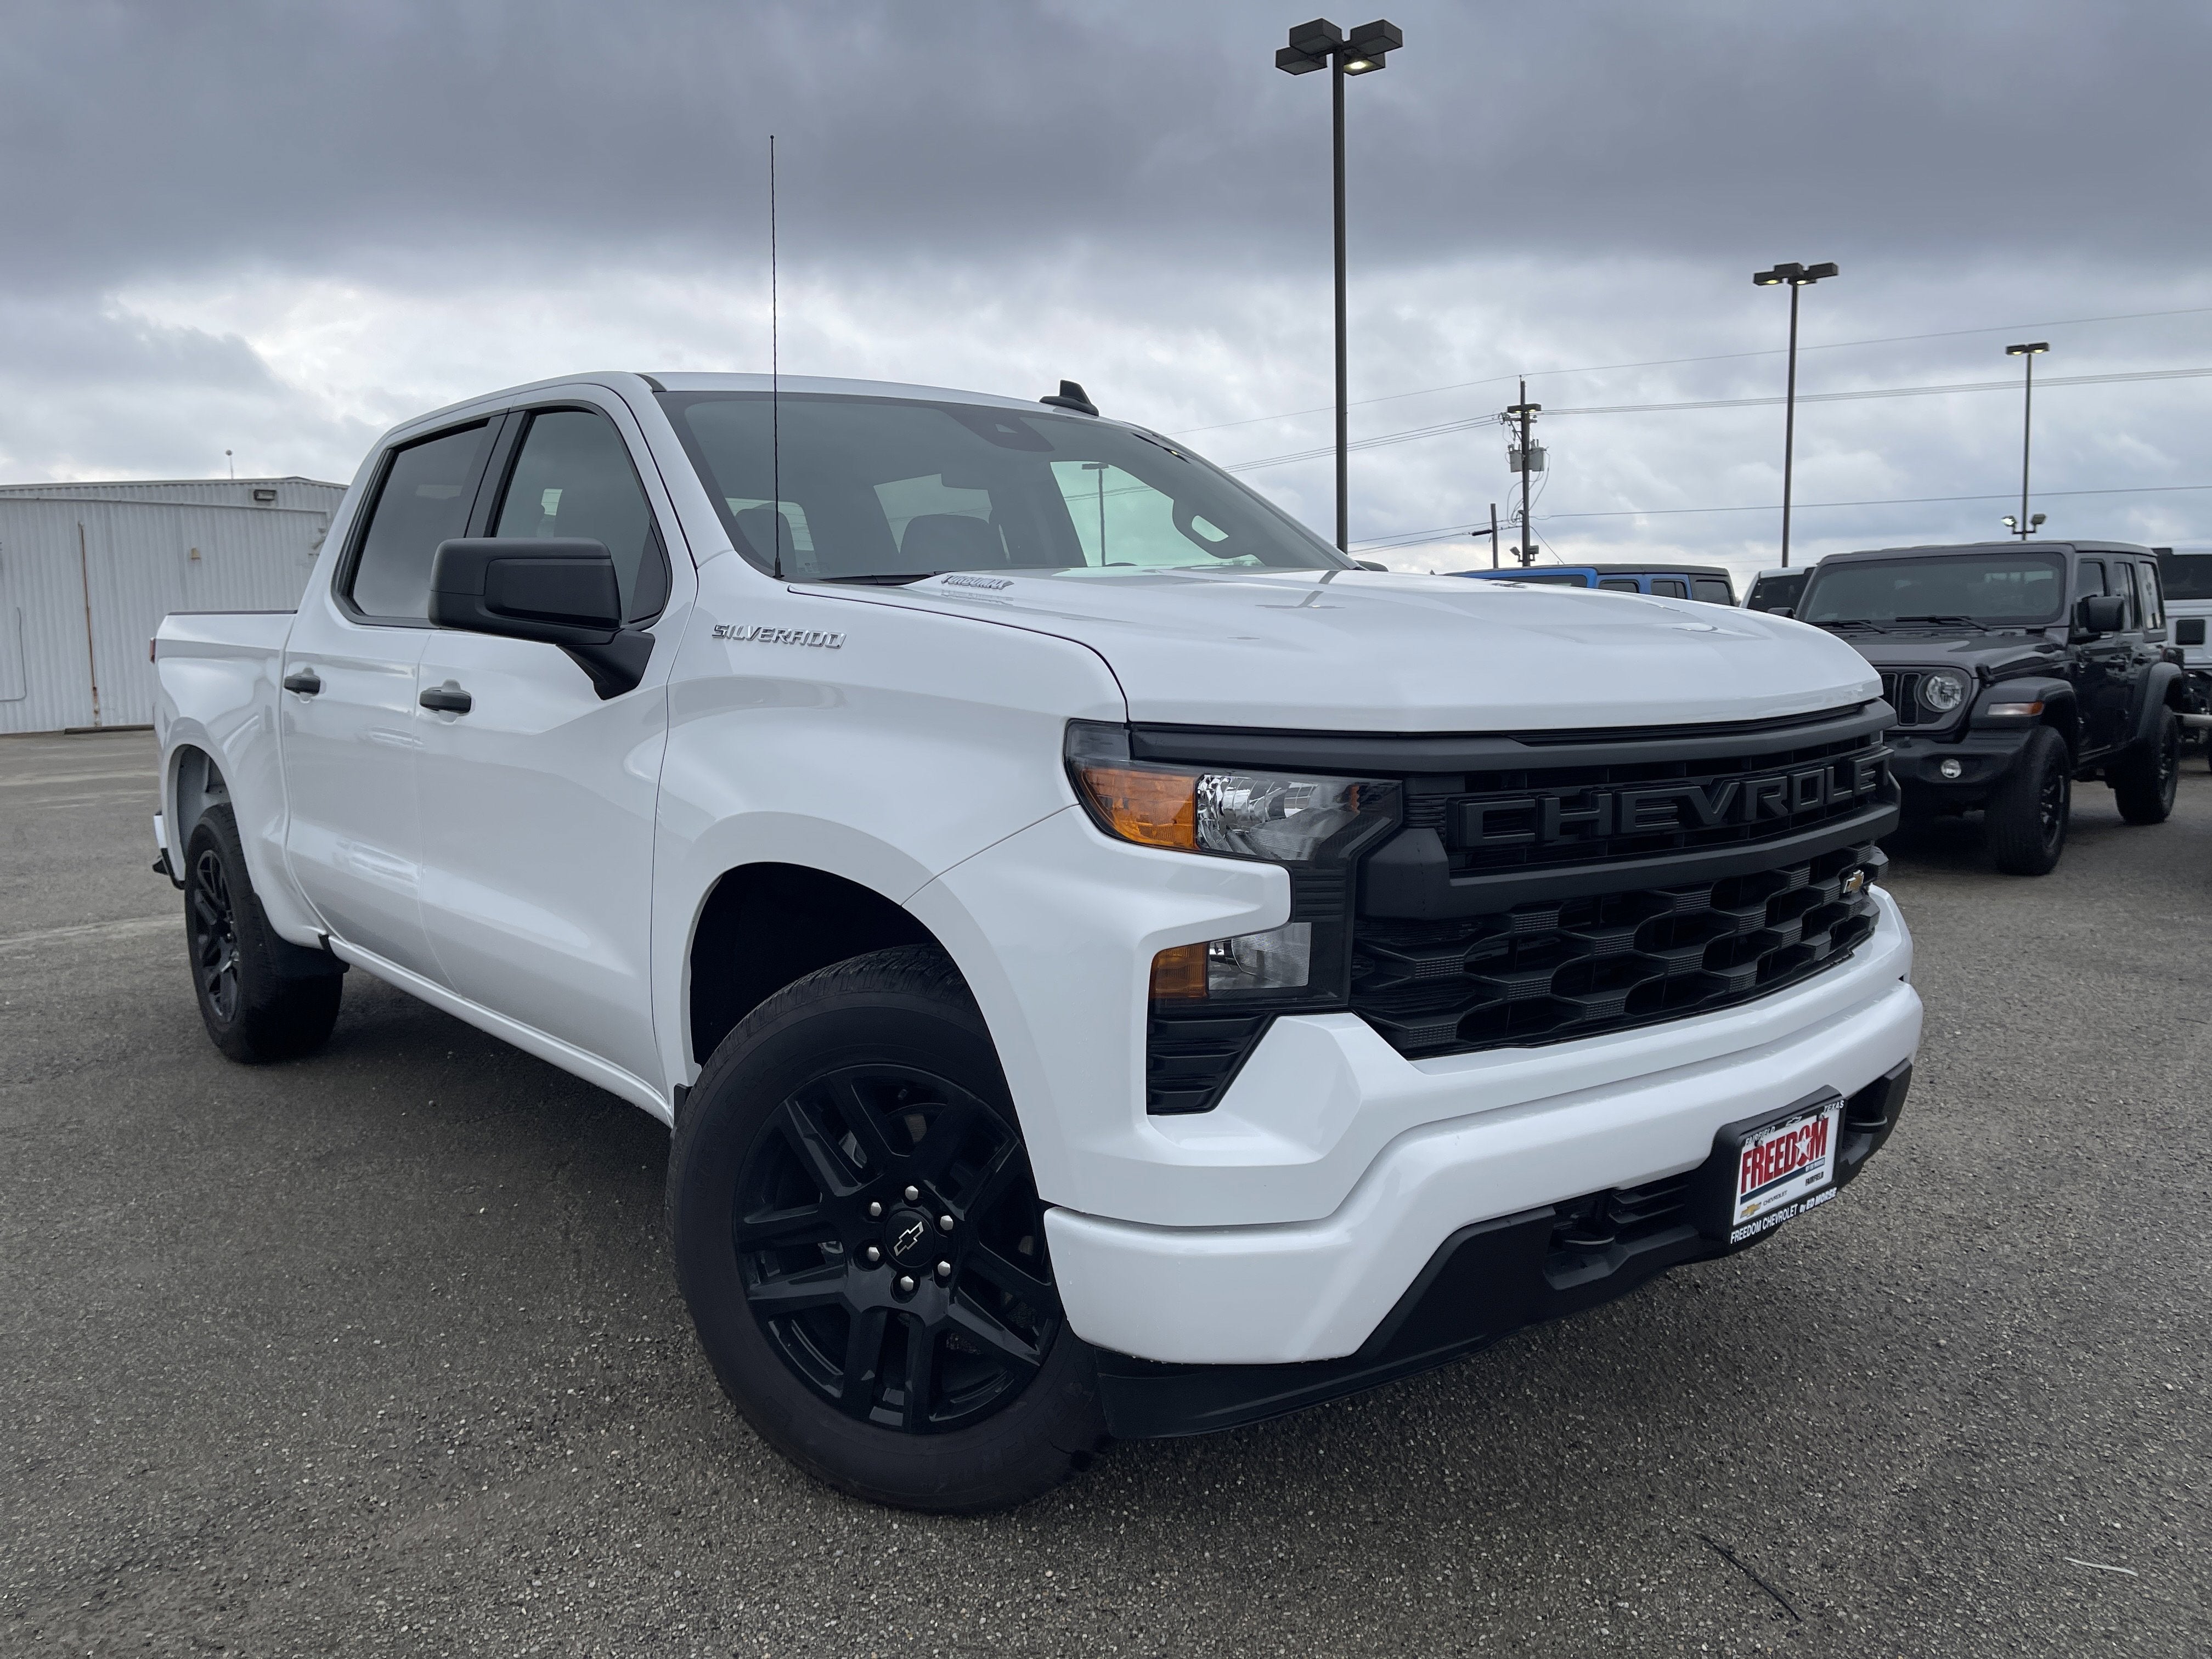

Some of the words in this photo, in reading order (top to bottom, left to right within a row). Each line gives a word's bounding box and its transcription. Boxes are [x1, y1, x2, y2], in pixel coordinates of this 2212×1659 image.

[940, 574, 1014, 590] TURBOMAX
[712, 624, 847, 649] SILVERADO
[1454, 747, 1895, 846] CHEVROLET
[1824, 1099, 1844, 1113] TEXAS
[1741, 1117, 1829, 1194] FREEDOM
[1763, 1190, 1788, 1206] CHEVROLET
[1730, 1220, 1762, 1244] FREEDOM
[1762, 1203, 1798, 1230] CHEVROLET
[1806, 1197, 1815, 1210] ED
[1815, 1187, 1837, 1206] MORSE
